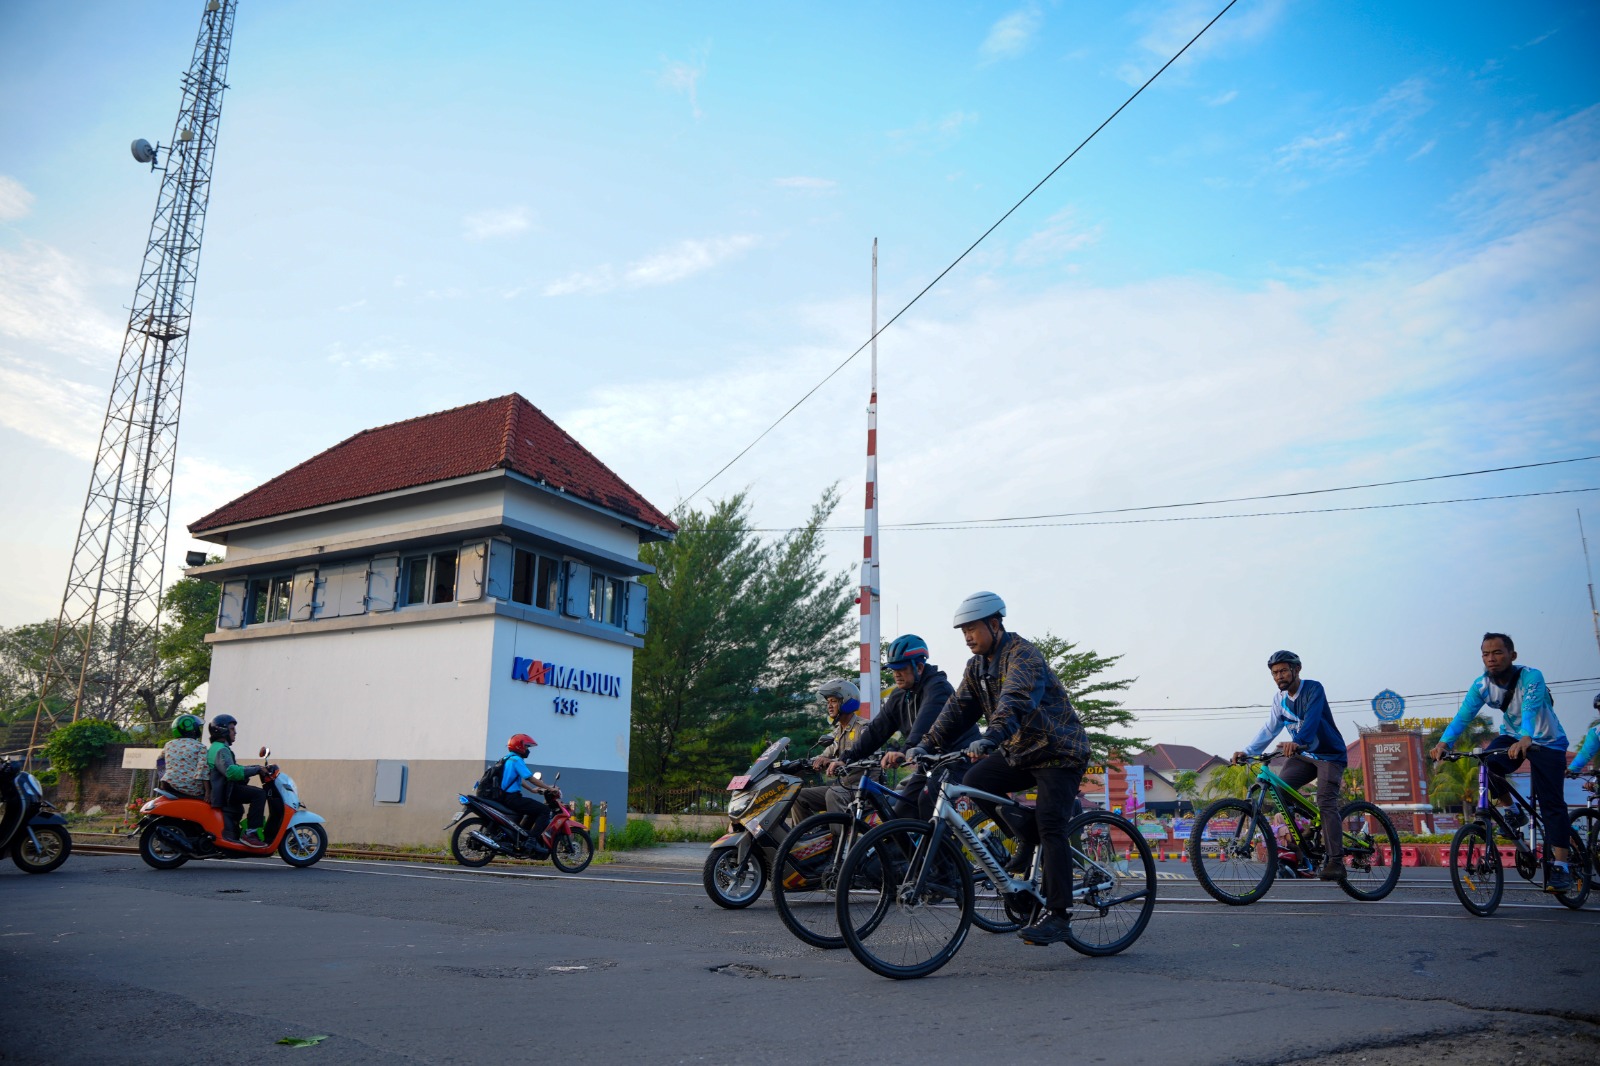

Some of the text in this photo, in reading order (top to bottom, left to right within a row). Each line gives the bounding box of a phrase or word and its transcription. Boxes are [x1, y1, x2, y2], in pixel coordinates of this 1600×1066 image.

[512, 656, 621, 698] KAI MADIUN
[553, 696, 579, 716] 138
[1374, 743, 1383, 753] 10
[1085, 766, 1104, 774] OTA
[959, 824, 1008, 883] SPECIALIZED
